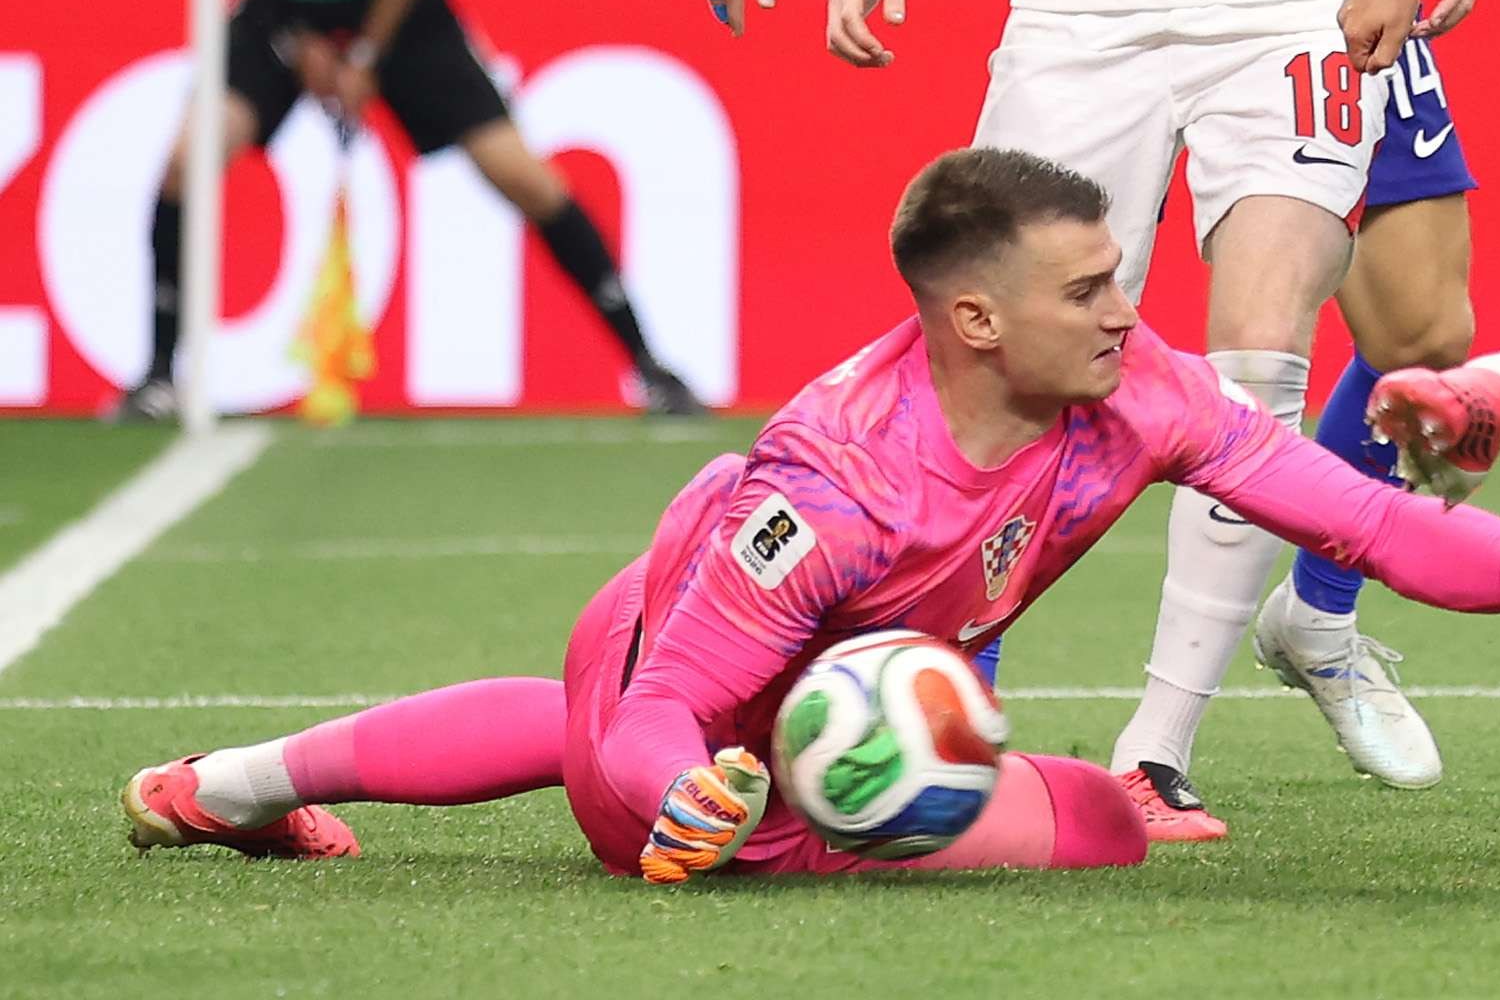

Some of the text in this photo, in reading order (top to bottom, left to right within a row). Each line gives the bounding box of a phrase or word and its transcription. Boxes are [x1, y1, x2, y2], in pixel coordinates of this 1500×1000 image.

[1284, 50, 1362, 148] 18
[1386, 37, 1448, 120] 14
[0, 43, 742, 414] on
